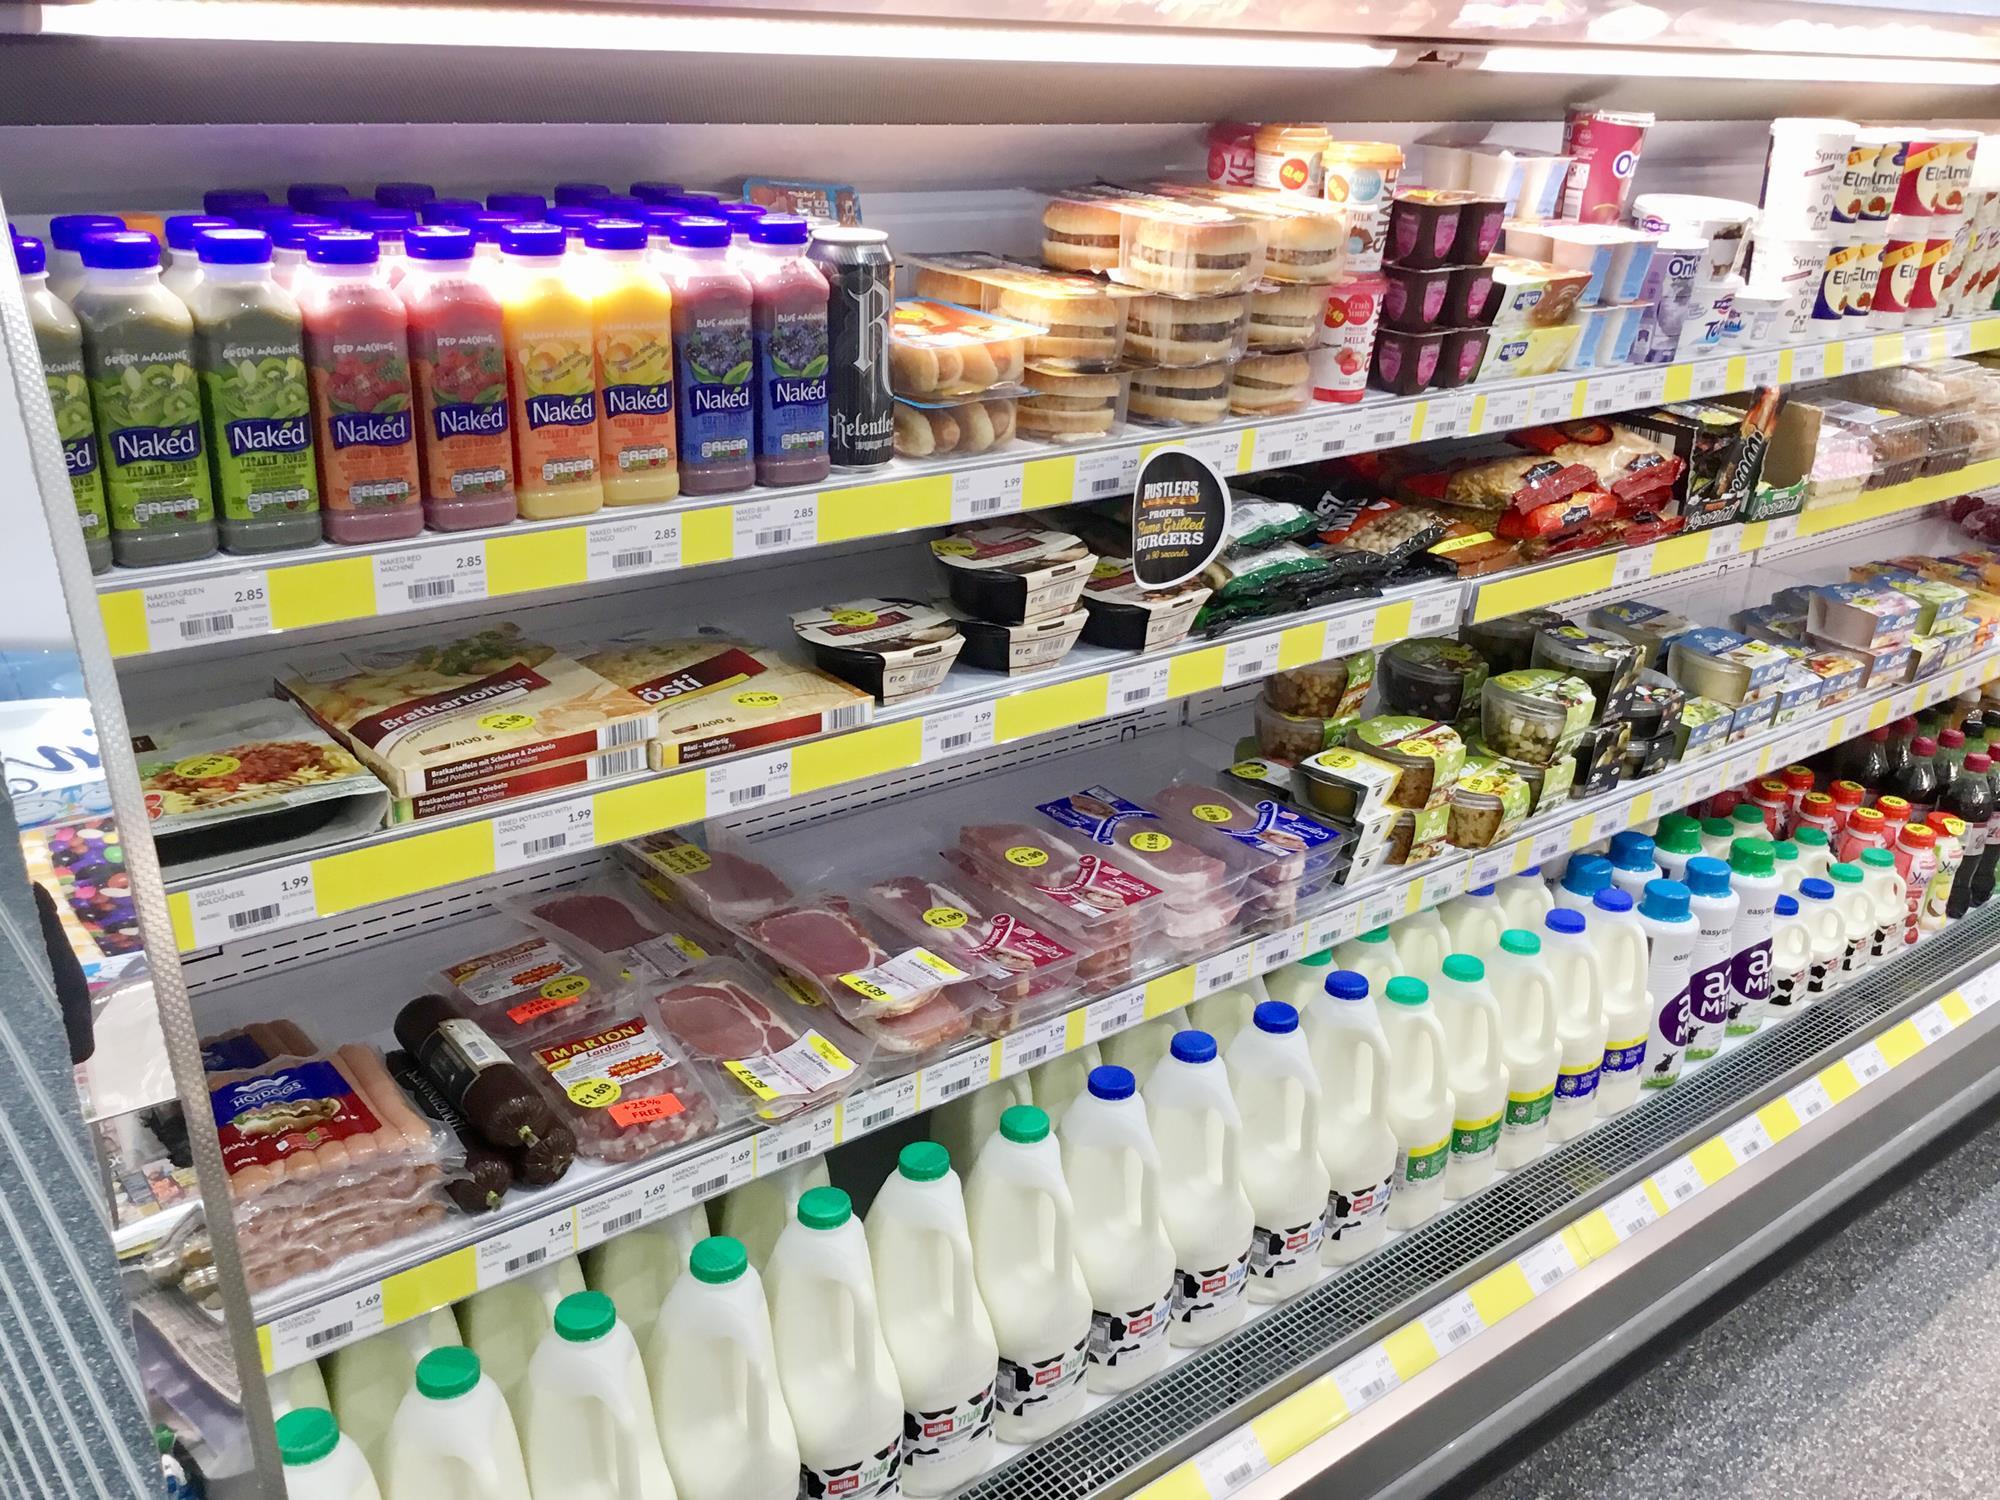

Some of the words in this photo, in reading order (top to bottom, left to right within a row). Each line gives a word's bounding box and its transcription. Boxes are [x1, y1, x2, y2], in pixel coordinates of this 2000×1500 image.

[1816, 150, 1846, 164] Spring
[1843, 170, 1871, 187] Elm
[1792, 256, 1824, 268] Spring
[438, 336, 456, 346] RED
[459, 335, 494, 345] MACHINE
[333, 344, 354, 354] RED
[356, 342, 395, 352] MACHINE
[832, 408, 894, 449] Relentle
[1122, 458, 1138, 470] 2.29
[1004, 477, 1020, 488] 1.99
[1144, 480, 1200, 500] RUSTLERS
[794, 508, 813, 519] 2.85
[1148, 508, 1185, 520] PROPER
[613, 526, 638, 534] MIGHTY
[1163, 516, 1205, 536] Grilled
[590, 535, 615, 544] MANGO
[655, 528, 676, 540] 2.85
[1136, 532, 1204, 552] BURGERS
[380, 556, 406, 566] NAKED
[408, 554, 422, 562] RED
[1160, 548, 1189, 558] seconds
[381, 564, 414, 573] MACHINE
[456, 555, 482, 569] 2.85
[146, 591, 176, 602] NAKED
[177, 587, 204, 598] GREEN
[234, 588, 264, 603] 2.85
[148, 598, 186, 608] MACHINE
[1265, 643, 1278, 654] 1.99
[1704, 636, 1736, 652] Deli
[1153, 668, 1168, 680] 1.99
[640, 673, 704, 704] östi
[380, 678, 533, 731] Bratkartoffeln
[738, 694, 778, 704] £1.99
[974, 712, 992, 723] 1.99
[1752, 703, 1772, 722] Deli
[493, 714, 525, 730] £1.99
[432, 761, 478, 778] Bratkartoffeln
[478, 758, 490, 766] mit
[490, 752, 520, 764] Schinken
[528, 742, 556, 756] Zwiebeln
[432, 774, 449, 786] Fried
[450, 770, 478, 782] Potatoes
[480, 766, 494, 774] with
[494, 762, 508, 771] Ham
[516, 755, 538, 766] Onions
[768, 762, 788, 774] 1.99
[418, 792, 466, 808] Bratkartoffeln
[478, 782, 508, 794] Zwiebeln
[418, 804, 436, 815] Fried
[439, 800, 467, 811] Potatoes
[468, 795, 482, 804] with
[482, 790, 505, 801] Onions
[498, 817, 517, 827] FRIED
[519, 810, 553, 823] POTATOES
[554, 806, 572, 814] WITH
[568, 809, 591, 823] 1.99
[499, 823, 526, 834] ONIONS
[1146, 834, 1158, 849] £1.99
[1014, 851, 1043, 864] £1.99
[282, 876, 309, 892] 1.99
[197, 890, 246, 907] BOLOGNESE
[931, 912, 963, 925] £1.99
[1747, 908, 1765, 916] easy
[1701, 928, 1722, 936] easy
[546, 980, 584, 998] £1.69
[855, 979, 887, 998] £1.39
[1049, 1026, 1064, 1038] 1.99
[550, 1025, 638, 1060] MARION
[586, 1040, 631, 1058] Lardons
[972, 1055, 990, 1068] 1.99
[738, 1070, 768, 1089] £1.39
[233, 1080, 302, 1108] HOTDOGS
[578, 1082, 612, 1105] £1.69
[896, 1084, 914, 1098] 1.99
[624, 1098, 662, 1111] +25%
[632, 1108, 663, 1118] FREE
[814, 1118, 832, 1132] 1.39
[731, 1150, 750, 1164] 1.69
[672, 1164, 696, 1178] MARION
[644, 1184, 666, 1198] 1.69
[582, 1200, 607, 1214] MARION
[582, 1204, 610, 1220] LARDONS
[548, 1222, 571, 1237] 1.49
[1288, 1236, 1307, 1248] müller
[1204, 1278, 1225, 1291] müller
[356, 1294, 380, 1310] 1.69
[1131, 1318, 1151, 1331] müller
[1038, 1368, 1059, 1382] müller
[926, 1422, 951, 1435] müller
[958, 1406, 981, 1427] milk
[831, 1478, 856, 1492] müller
[864, 1460, 888, 1482] milk
